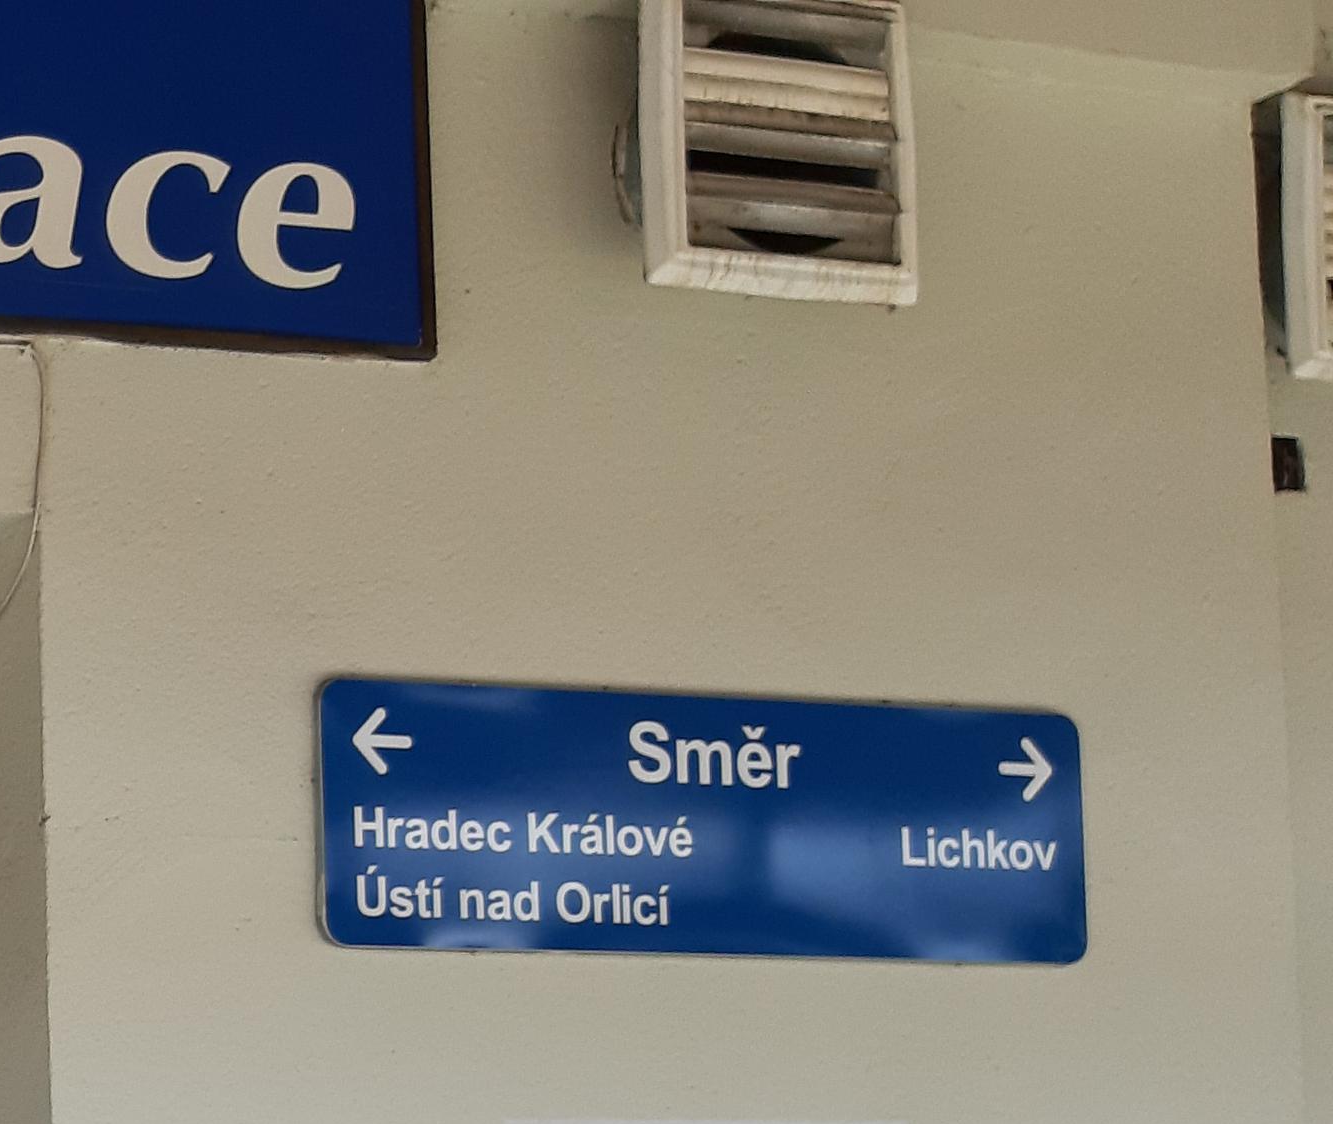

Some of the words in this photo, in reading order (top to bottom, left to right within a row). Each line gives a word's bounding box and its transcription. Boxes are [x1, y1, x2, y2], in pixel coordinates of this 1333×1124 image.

[627, 720, 802, 790] Směr
[352, 805, 513, 853] Hradec
[526, 811, 694, 859] Králové
[900, 825, 1058, 871] Lichkov
[355, 864, 444, 919] Ústí
[458, 879, 540, 922] nad
[555, 880, 670, 927] Orlicí
